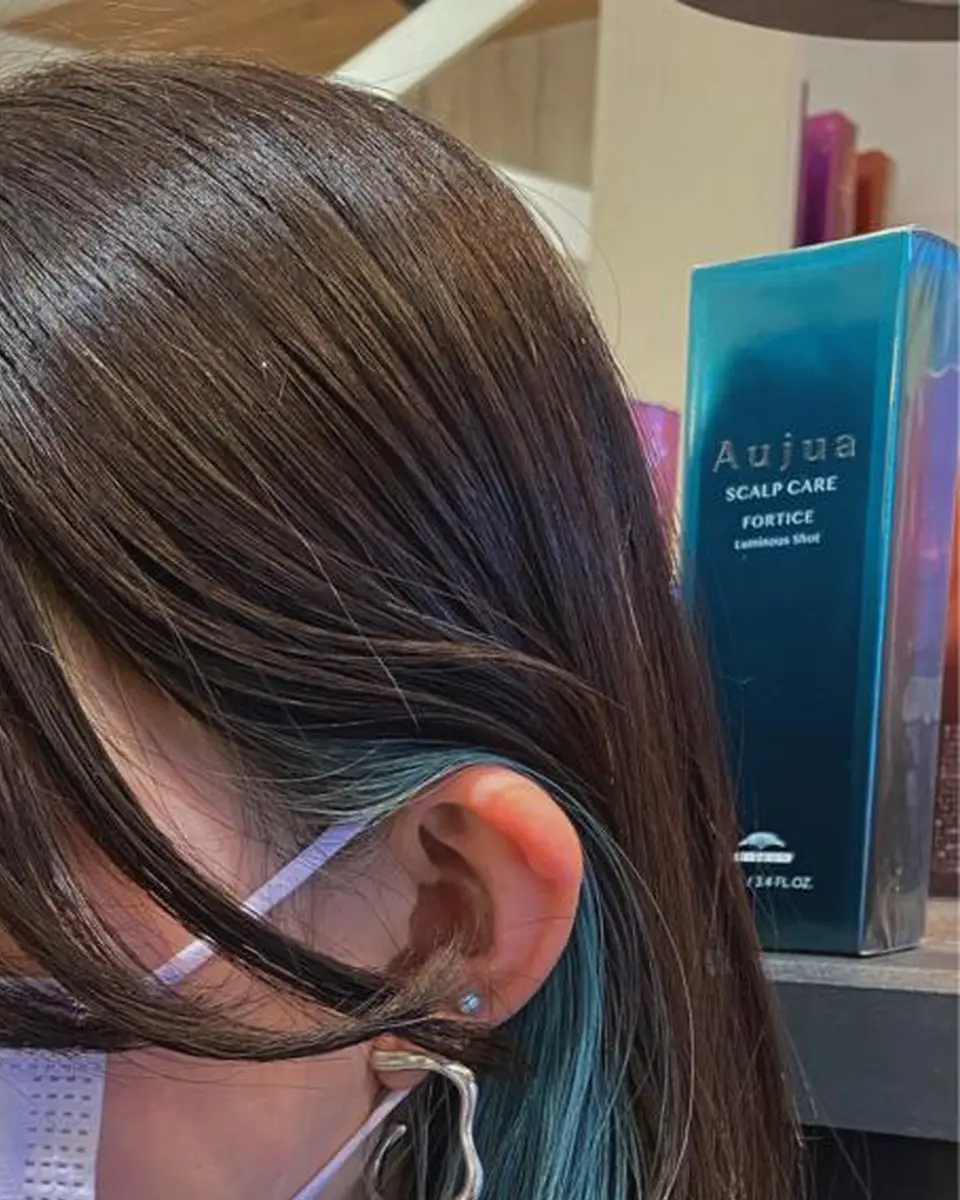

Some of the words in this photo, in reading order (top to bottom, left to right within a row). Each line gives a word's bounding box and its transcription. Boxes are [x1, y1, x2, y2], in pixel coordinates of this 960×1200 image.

[713, 432, 856, 473] Aujua
[726, 482, 783, 502] SCALP
[787, 475, 838, 496] CARE
[742, 509, 815, 530] FORTICE
[734, 534, 789, 550] Luminous
[792, 532, 821, 546] Shot
